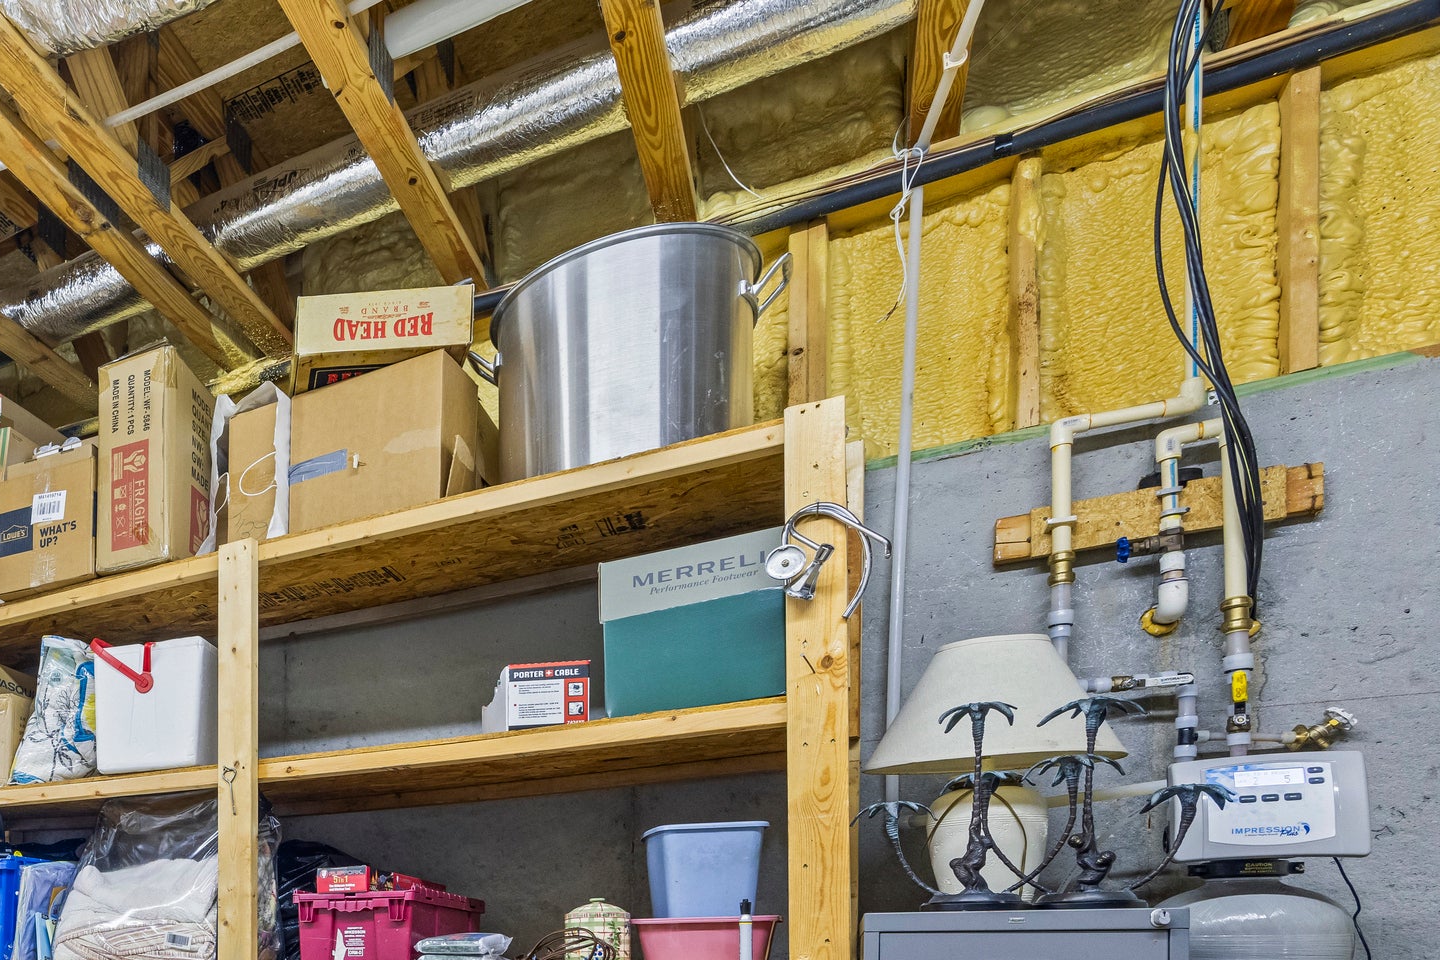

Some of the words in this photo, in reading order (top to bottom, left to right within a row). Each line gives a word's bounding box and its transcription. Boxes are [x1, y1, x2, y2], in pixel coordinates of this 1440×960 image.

[361, 305, 409, 315] BRAND
[333, 318, 387, 342] HEAD
[393, 312, 434, 338] RED
[111, 379, 119, 400] MADE
[127, 374, 135, 414] QUANTITY:
[142, 369, 151, 398] MODEL:
[111, 410, 119, 434] CHINA
[127, 420, 135, 436] PCS
[191, 466, 209, 491] MADE
[2, 529, 27, 541] LOWE'S
[39, 520, 77, 537] WHAT'S
[39, 535, 58, 548] UP?
[650, 578, 710, 596] Performance
[711, 569, 759, 584] Footwear
[513, 670, 544, 679] PORTER
[554, 668, 580, 676] CABLE
[1231, 825, 1300, 835] IMPRESSION
